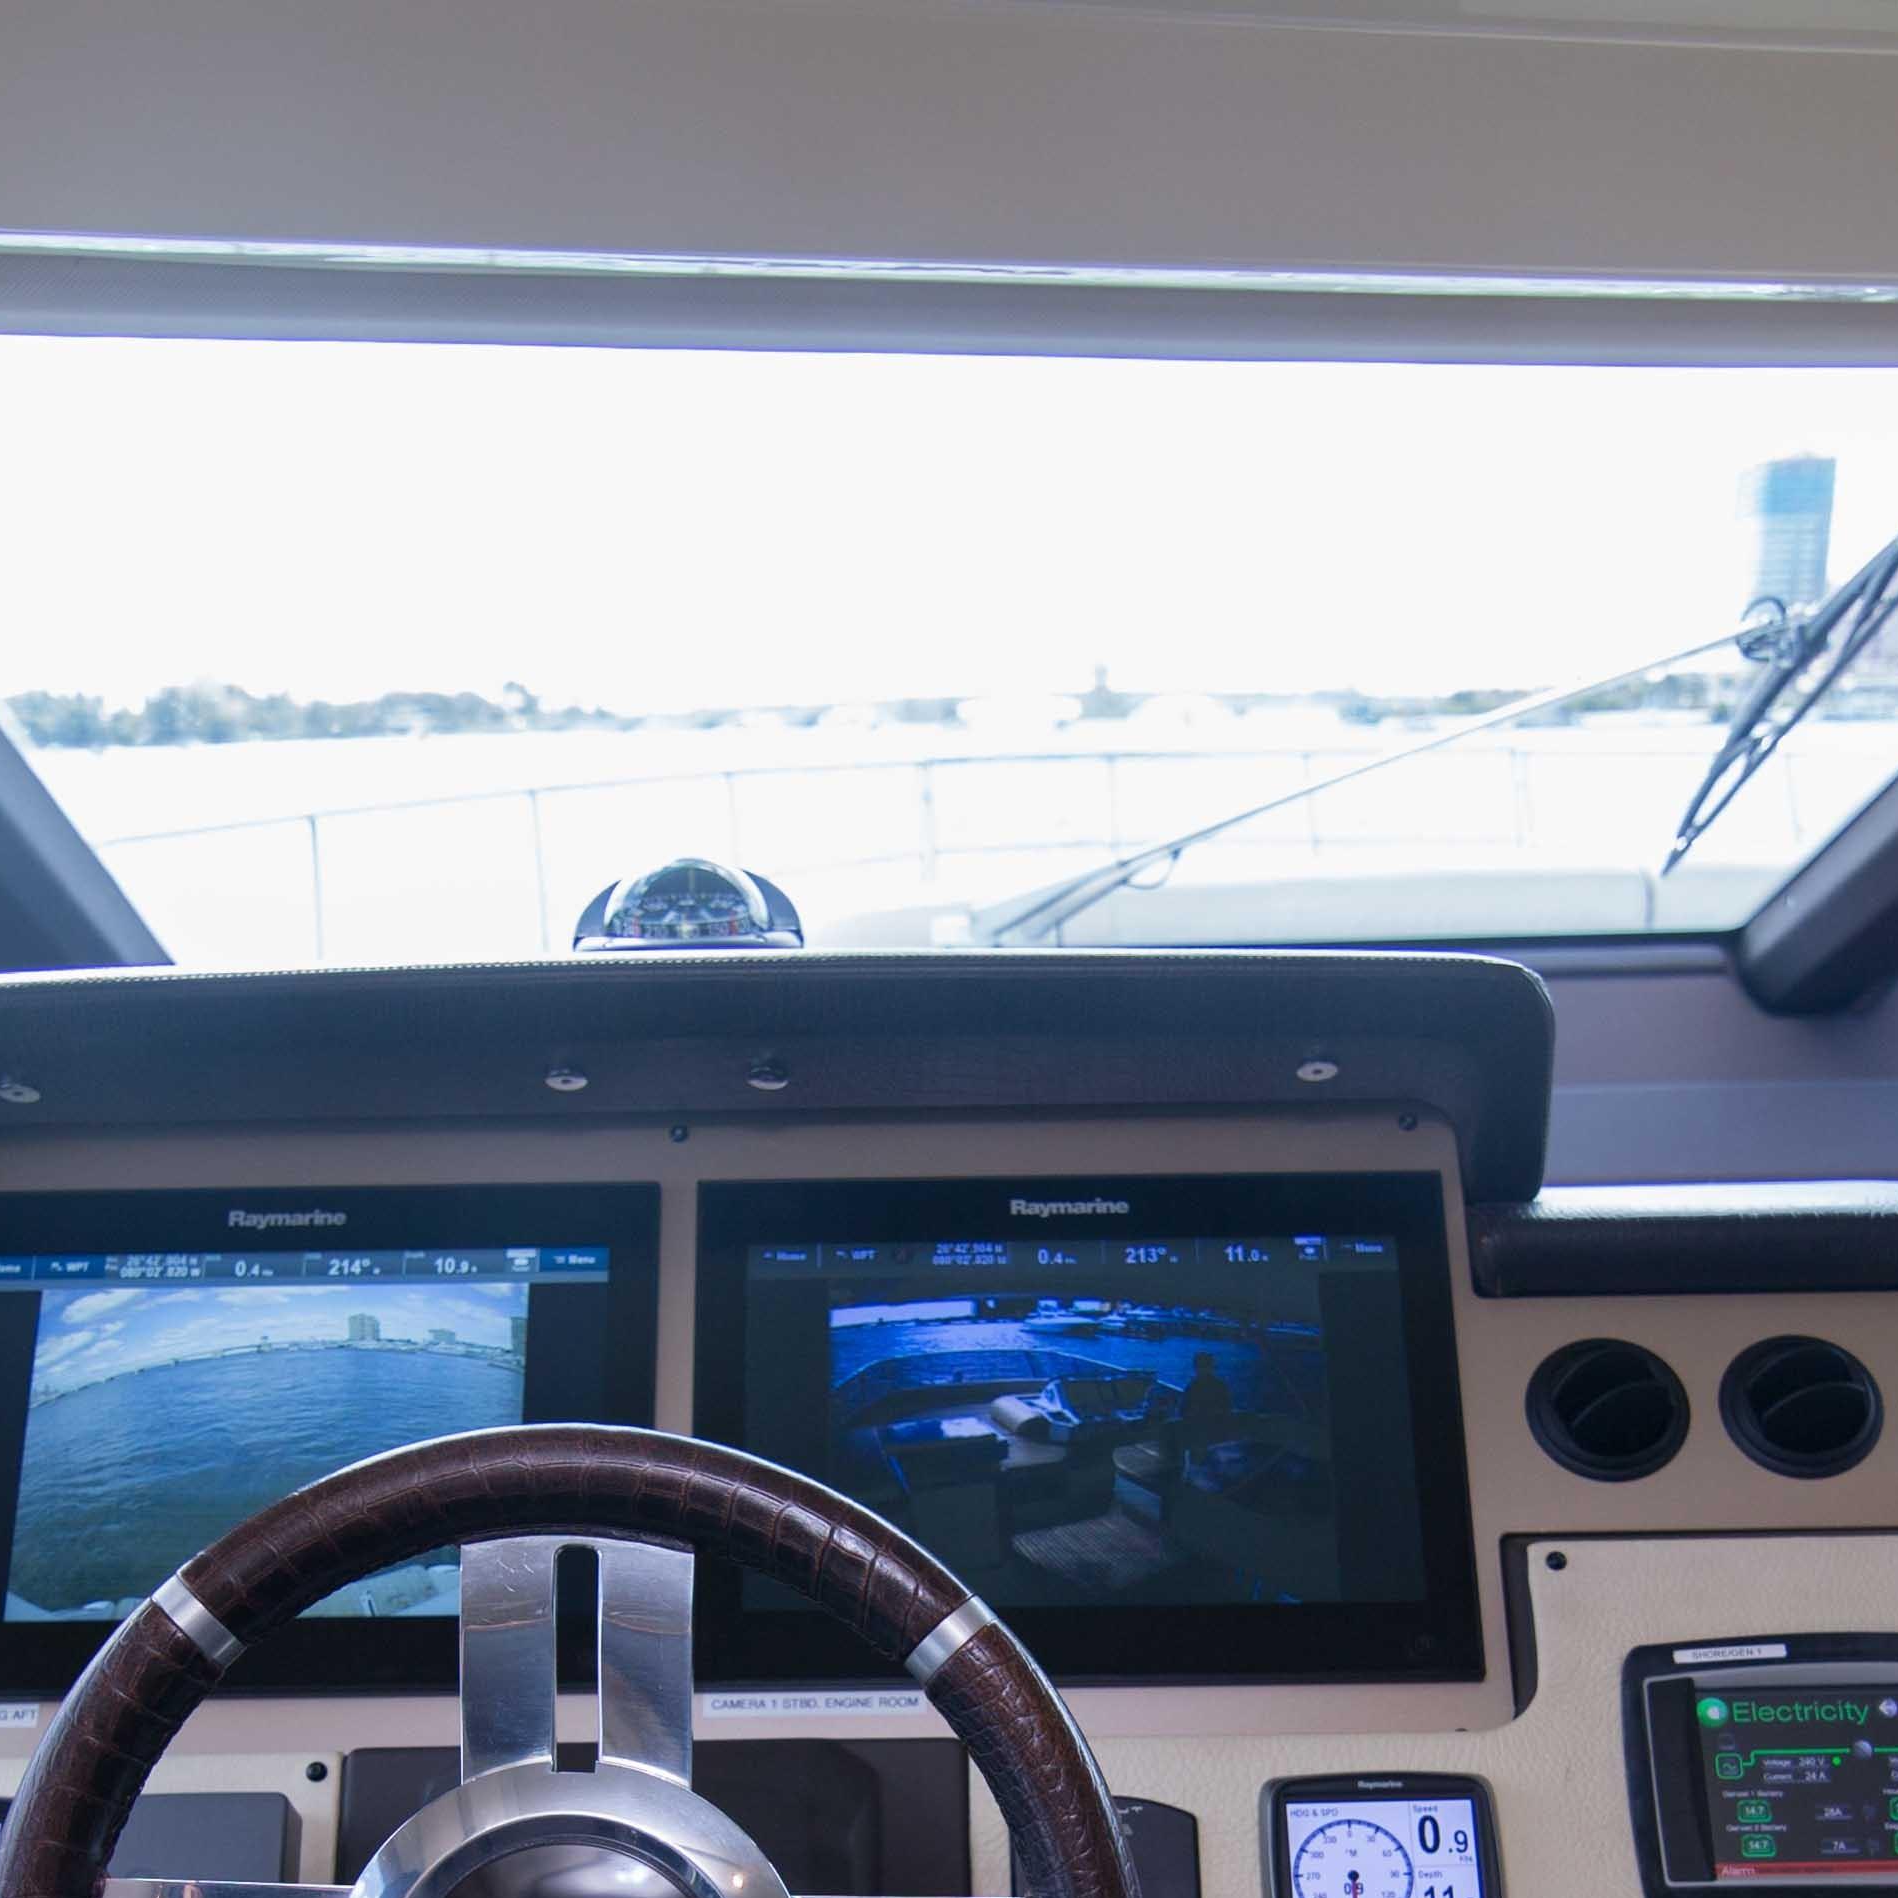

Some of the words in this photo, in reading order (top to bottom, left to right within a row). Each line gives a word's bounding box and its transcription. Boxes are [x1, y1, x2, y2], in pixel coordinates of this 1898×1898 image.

[1010, 1198, 1129, 1217] Raymarine
[228, 1209, 346, 1230] Raymarine
[1037, 1248, 1063, 1265] 0.4
[235, 1260, 261, 1276] 0.4
[434, 1258, 469, 1275] 10.9
[711, 1699, 766, 1710] CAMERA
[826, 1697, 873, 1709] ENGINE
[879, 1696, 919, 1708] ROOM
[13, 1709, 37, 1720] AFT
[1732, 1699, 1869, 1725] Electricity
[1418, 1814, 1469, 1854] 0.9
